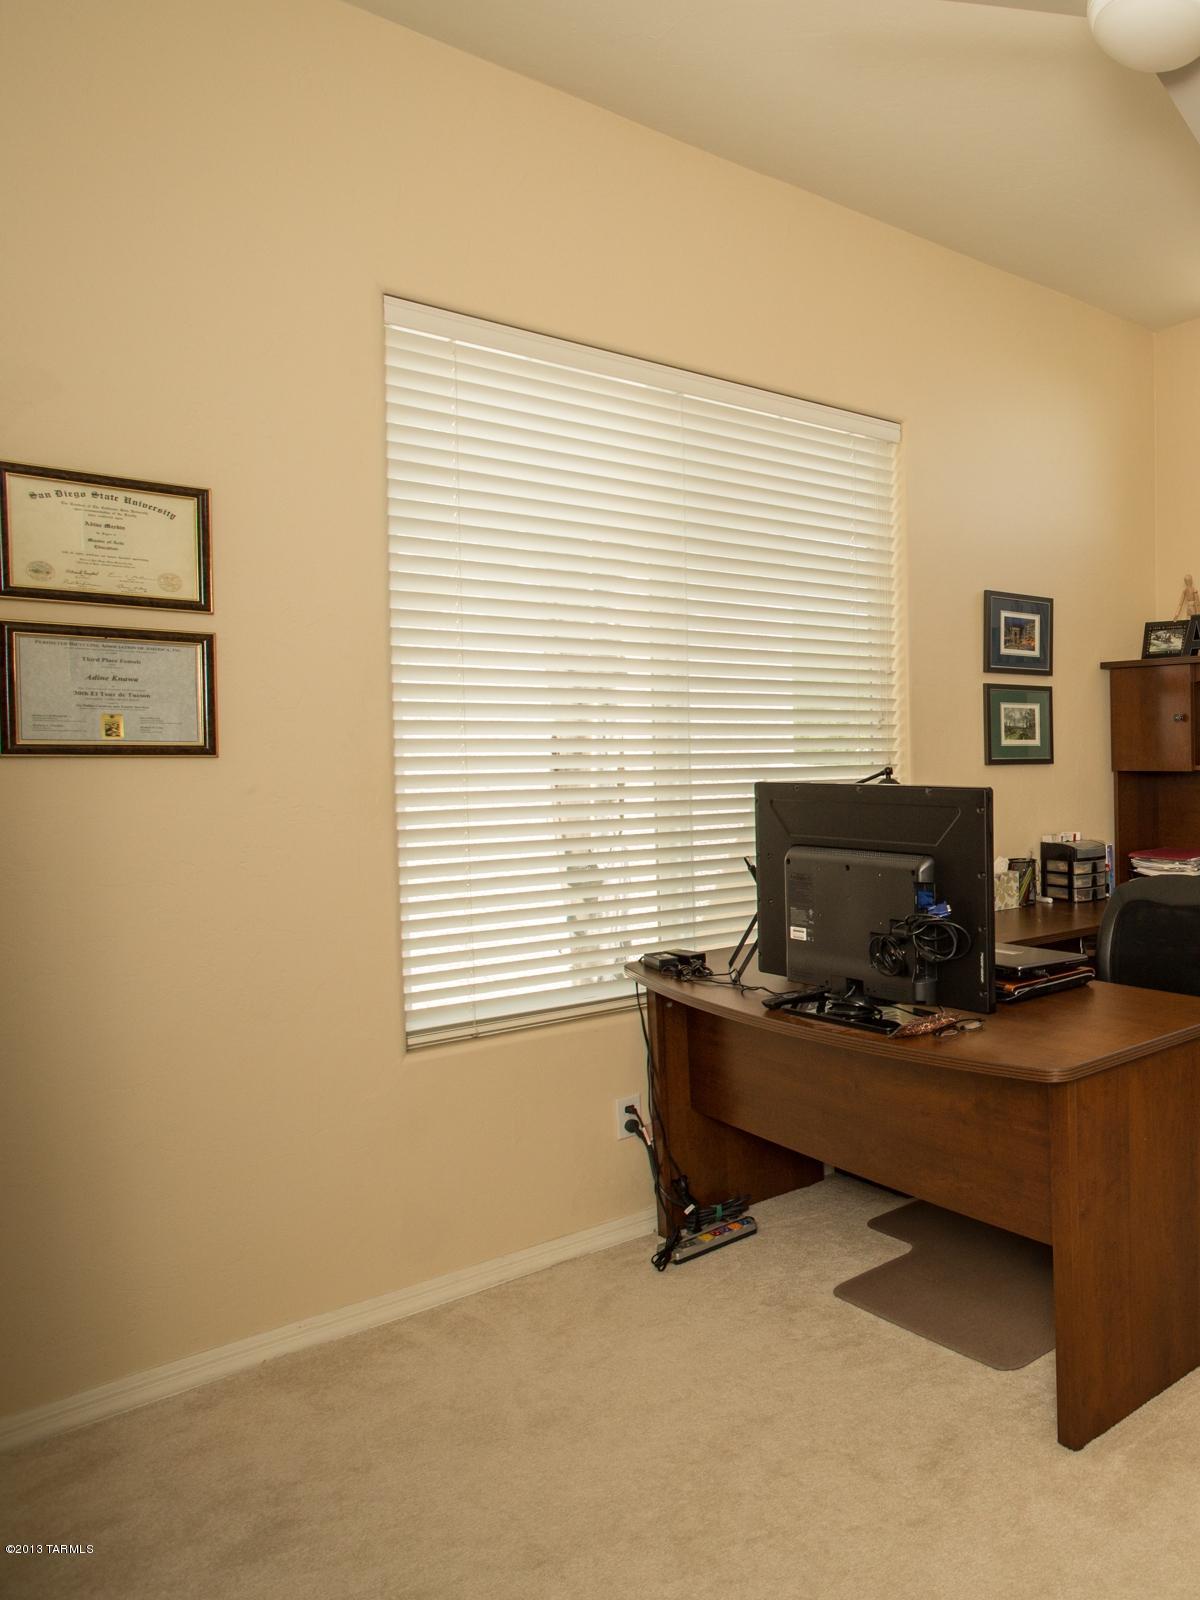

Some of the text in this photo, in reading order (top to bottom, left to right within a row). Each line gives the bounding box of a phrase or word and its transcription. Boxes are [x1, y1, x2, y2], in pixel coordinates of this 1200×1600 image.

[29, 491, 51, 499] San
[54, 489, 86, 499] Diego
[91, 491, 119, 502] State
[124, 496, 176, 520] University
